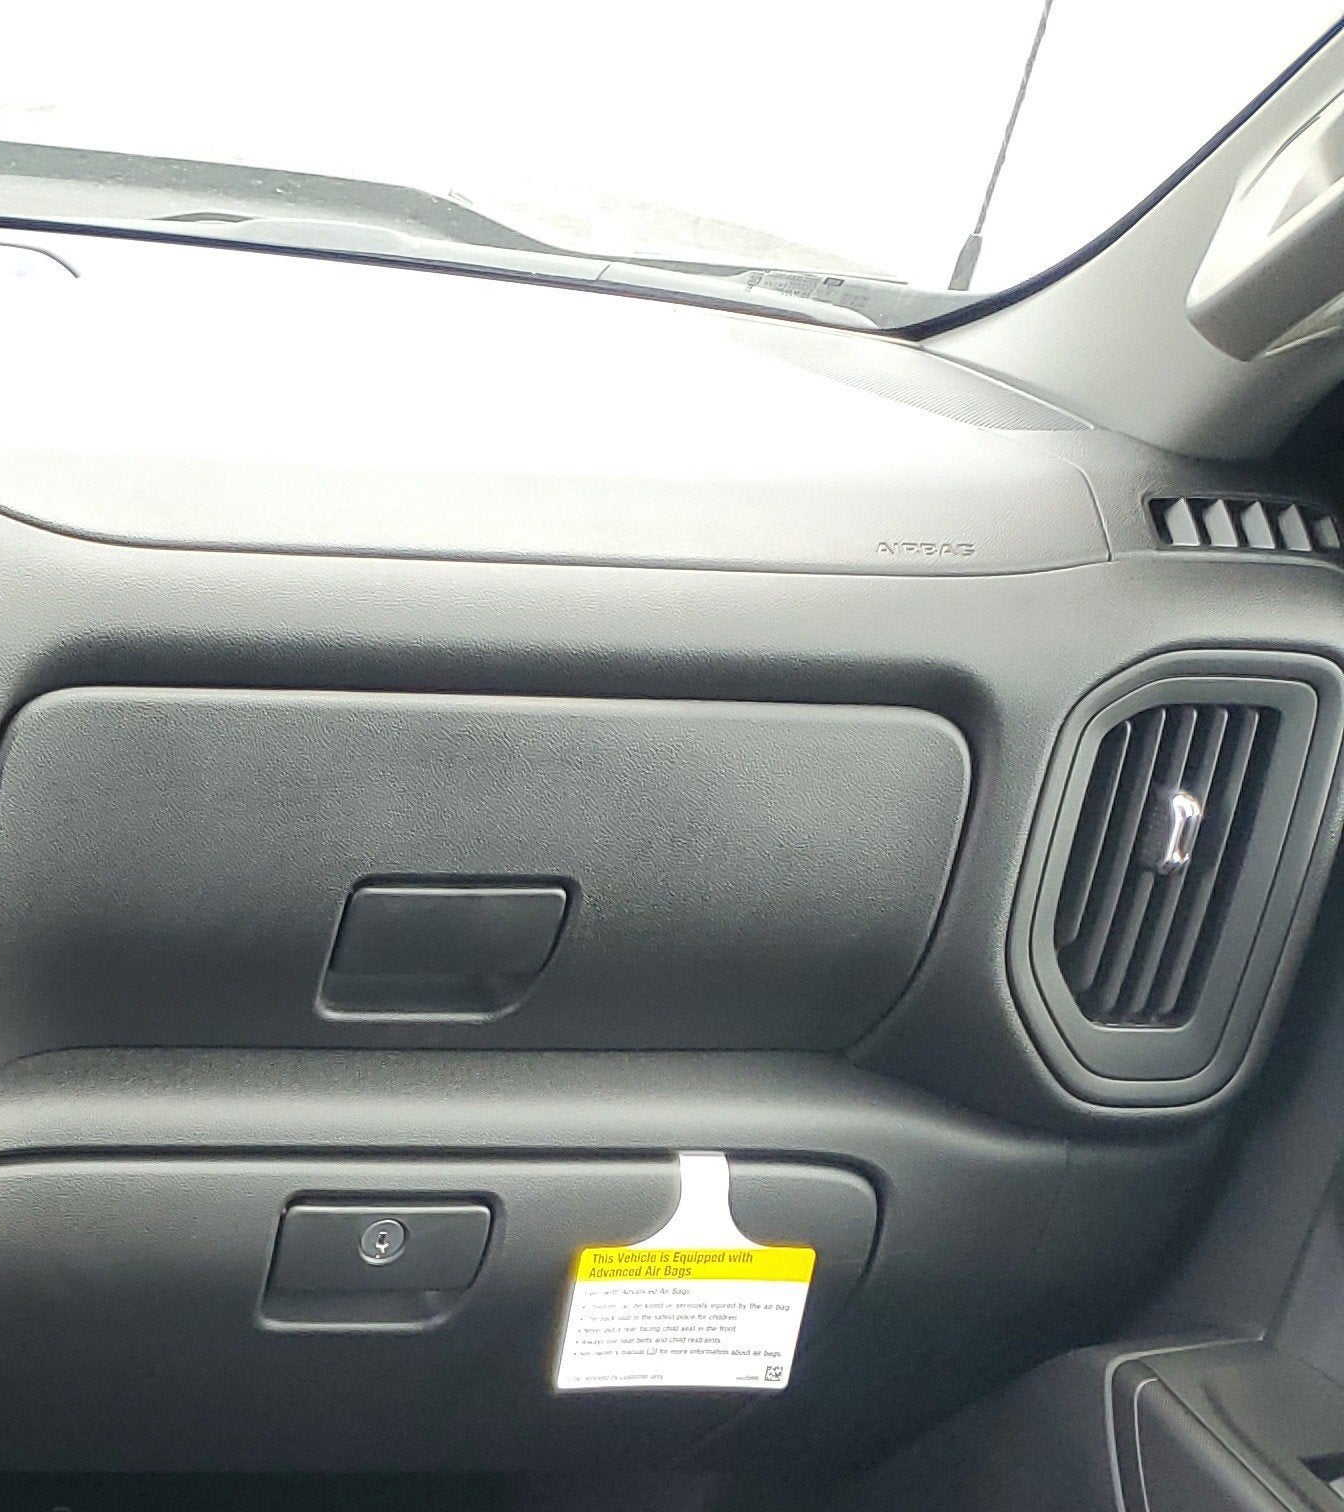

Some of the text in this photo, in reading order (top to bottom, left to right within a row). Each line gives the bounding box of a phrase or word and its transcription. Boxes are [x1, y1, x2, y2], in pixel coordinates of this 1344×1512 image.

[876, 541, 976, 557] AIRBAG
[593, 1251, 754, 1265] This Vehicle is Equipped with
[588, 1265, 692, 1278] Advanced Air Bags
